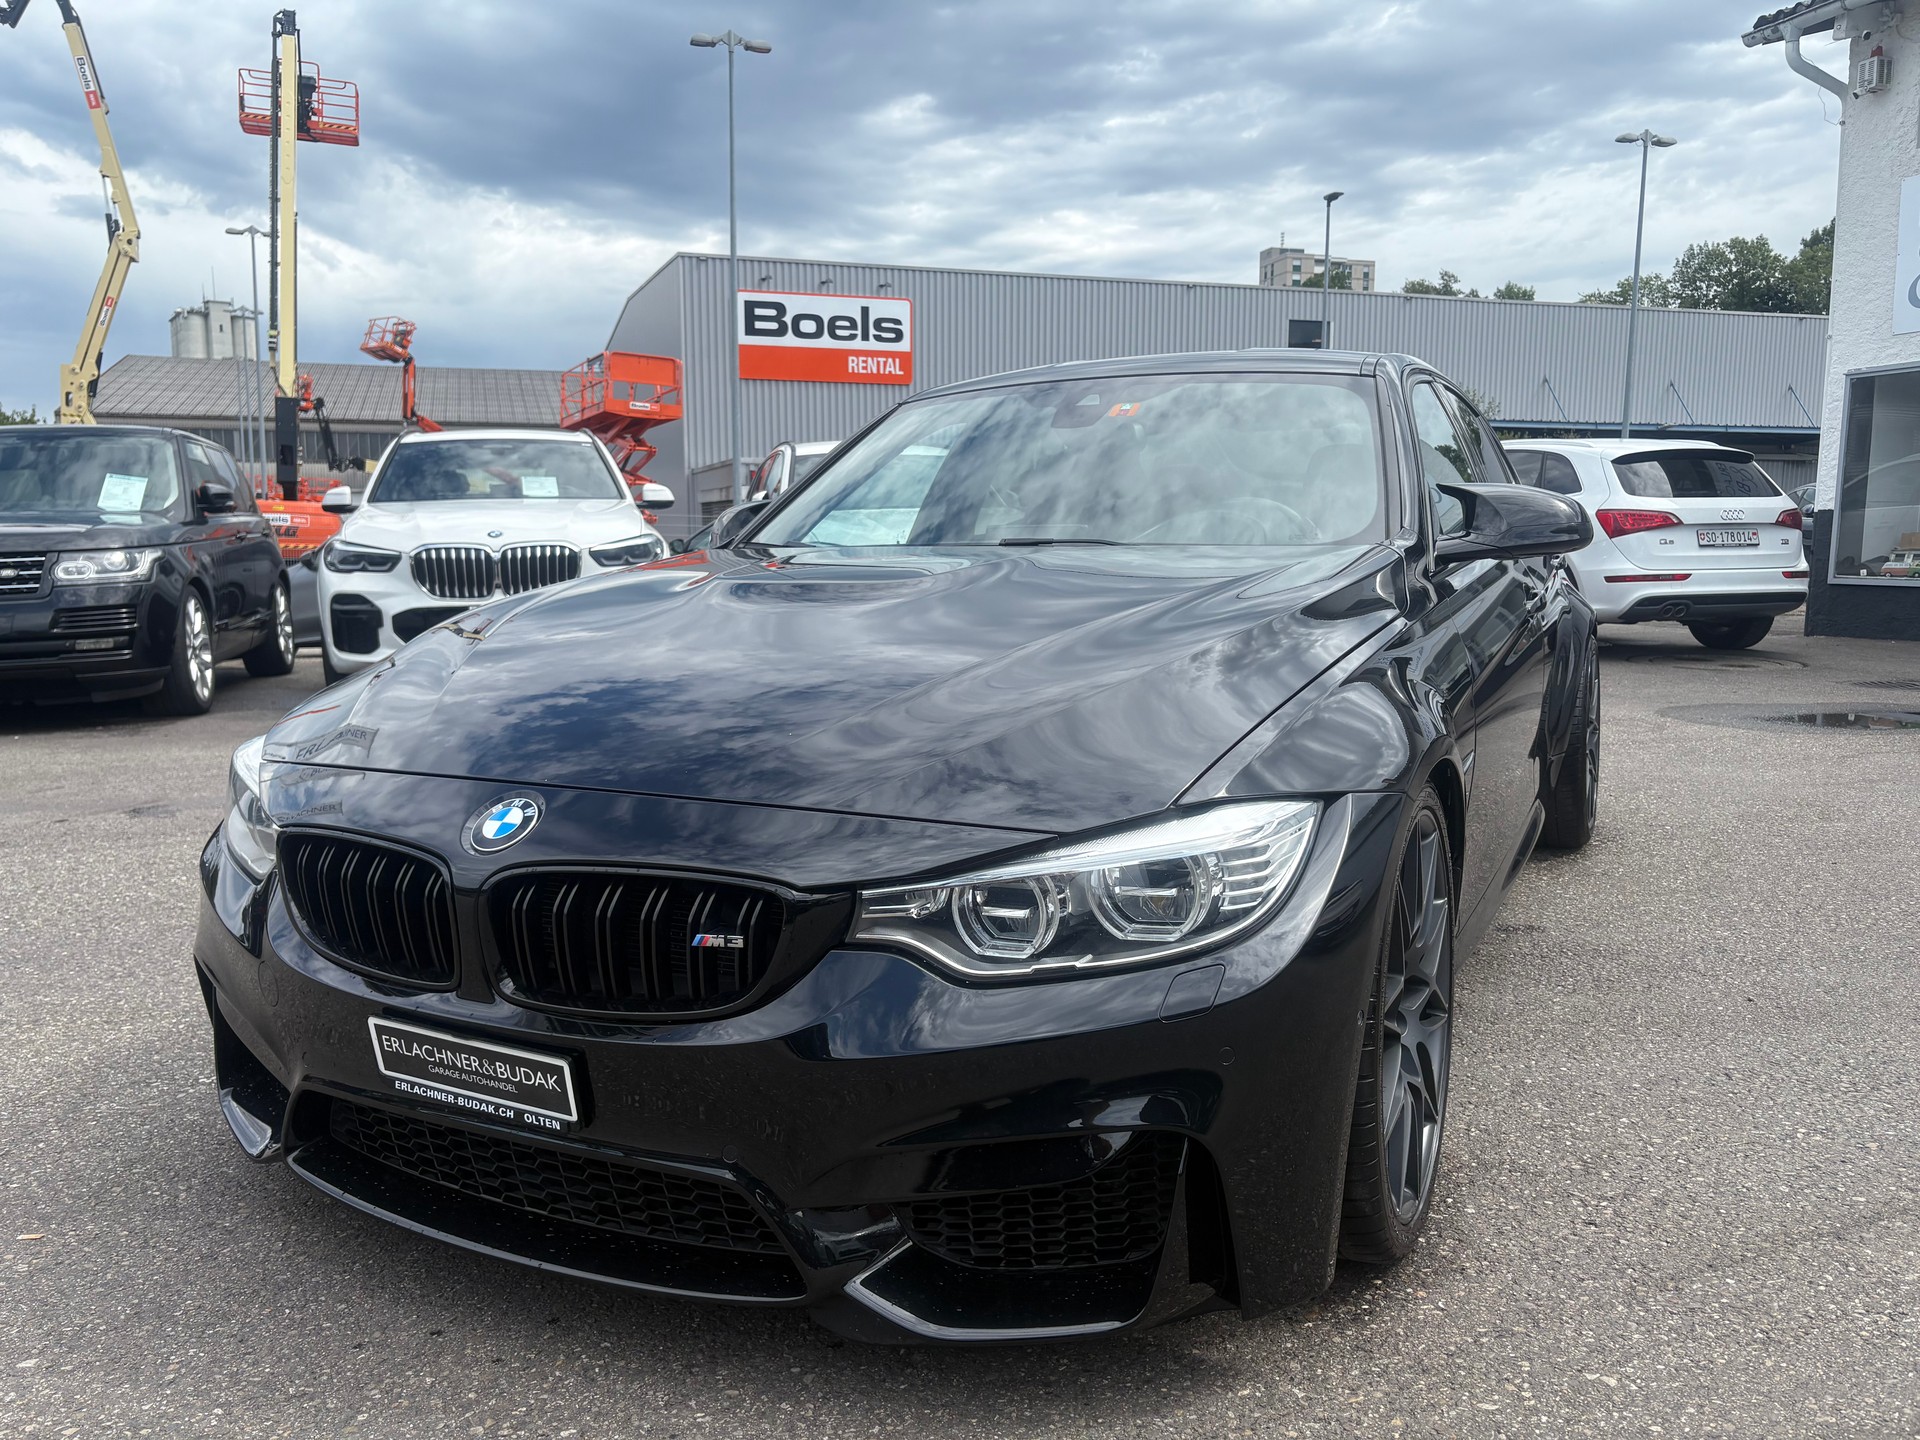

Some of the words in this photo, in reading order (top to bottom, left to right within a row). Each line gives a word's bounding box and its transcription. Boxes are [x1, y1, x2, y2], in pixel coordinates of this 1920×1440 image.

[744, 300, 904, 344] Boels
[848, 356, 904, 375] RENTAL
[492, 799, 536, 817] BMW
[705, 934, 744, 948] M3
[381, 1035, 562, 1092] ERLACHNER&BUDAK
[428, 1064, 460, 1080] GARAGE
[461, 1073, 518, 1093] AUTOHANDEL
[395, 1080, 514, 1119] ERLACHNER-BUDAK.CH
[524, 1113, 561, 1130] OLTEN
